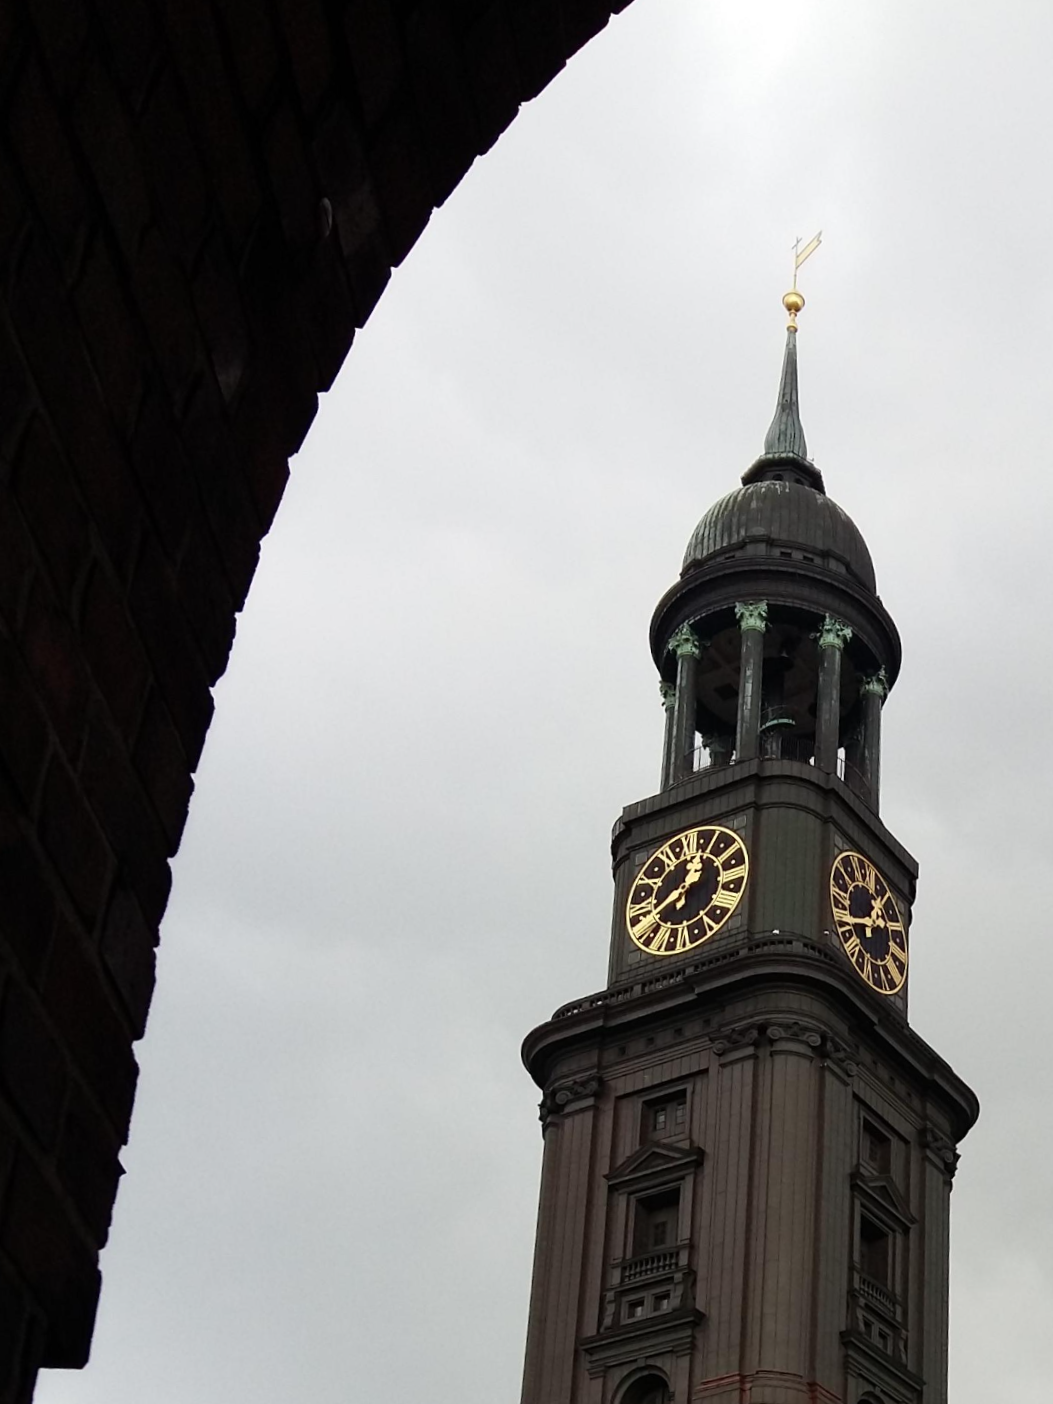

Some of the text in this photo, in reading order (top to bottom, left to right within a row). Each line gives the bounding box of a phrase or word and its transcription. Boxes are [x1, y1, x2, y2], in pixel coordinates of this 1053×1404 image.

[680, 831, 698, 859] XII
[706, 830, 721, 853] I
[718, 841, 741, 863] II
[657, 846, 678, 871] XI
[849, 856, 863, 882] XI
[637, 875, 661, 890] X
[722, 864, 746, 883] III
[837, 860, 853, 887] X
[865, 862, 875, 892] XII
[630, 897, 652, 918] IX
[702, 915, 720, 934] V
[649, 926, 672, 952] VII
[676, 927, 692, 951] VI
[846, 936, 860, 963] VII
[863, 956, 873, 985] VI
[880, 966, 890, 991] V
